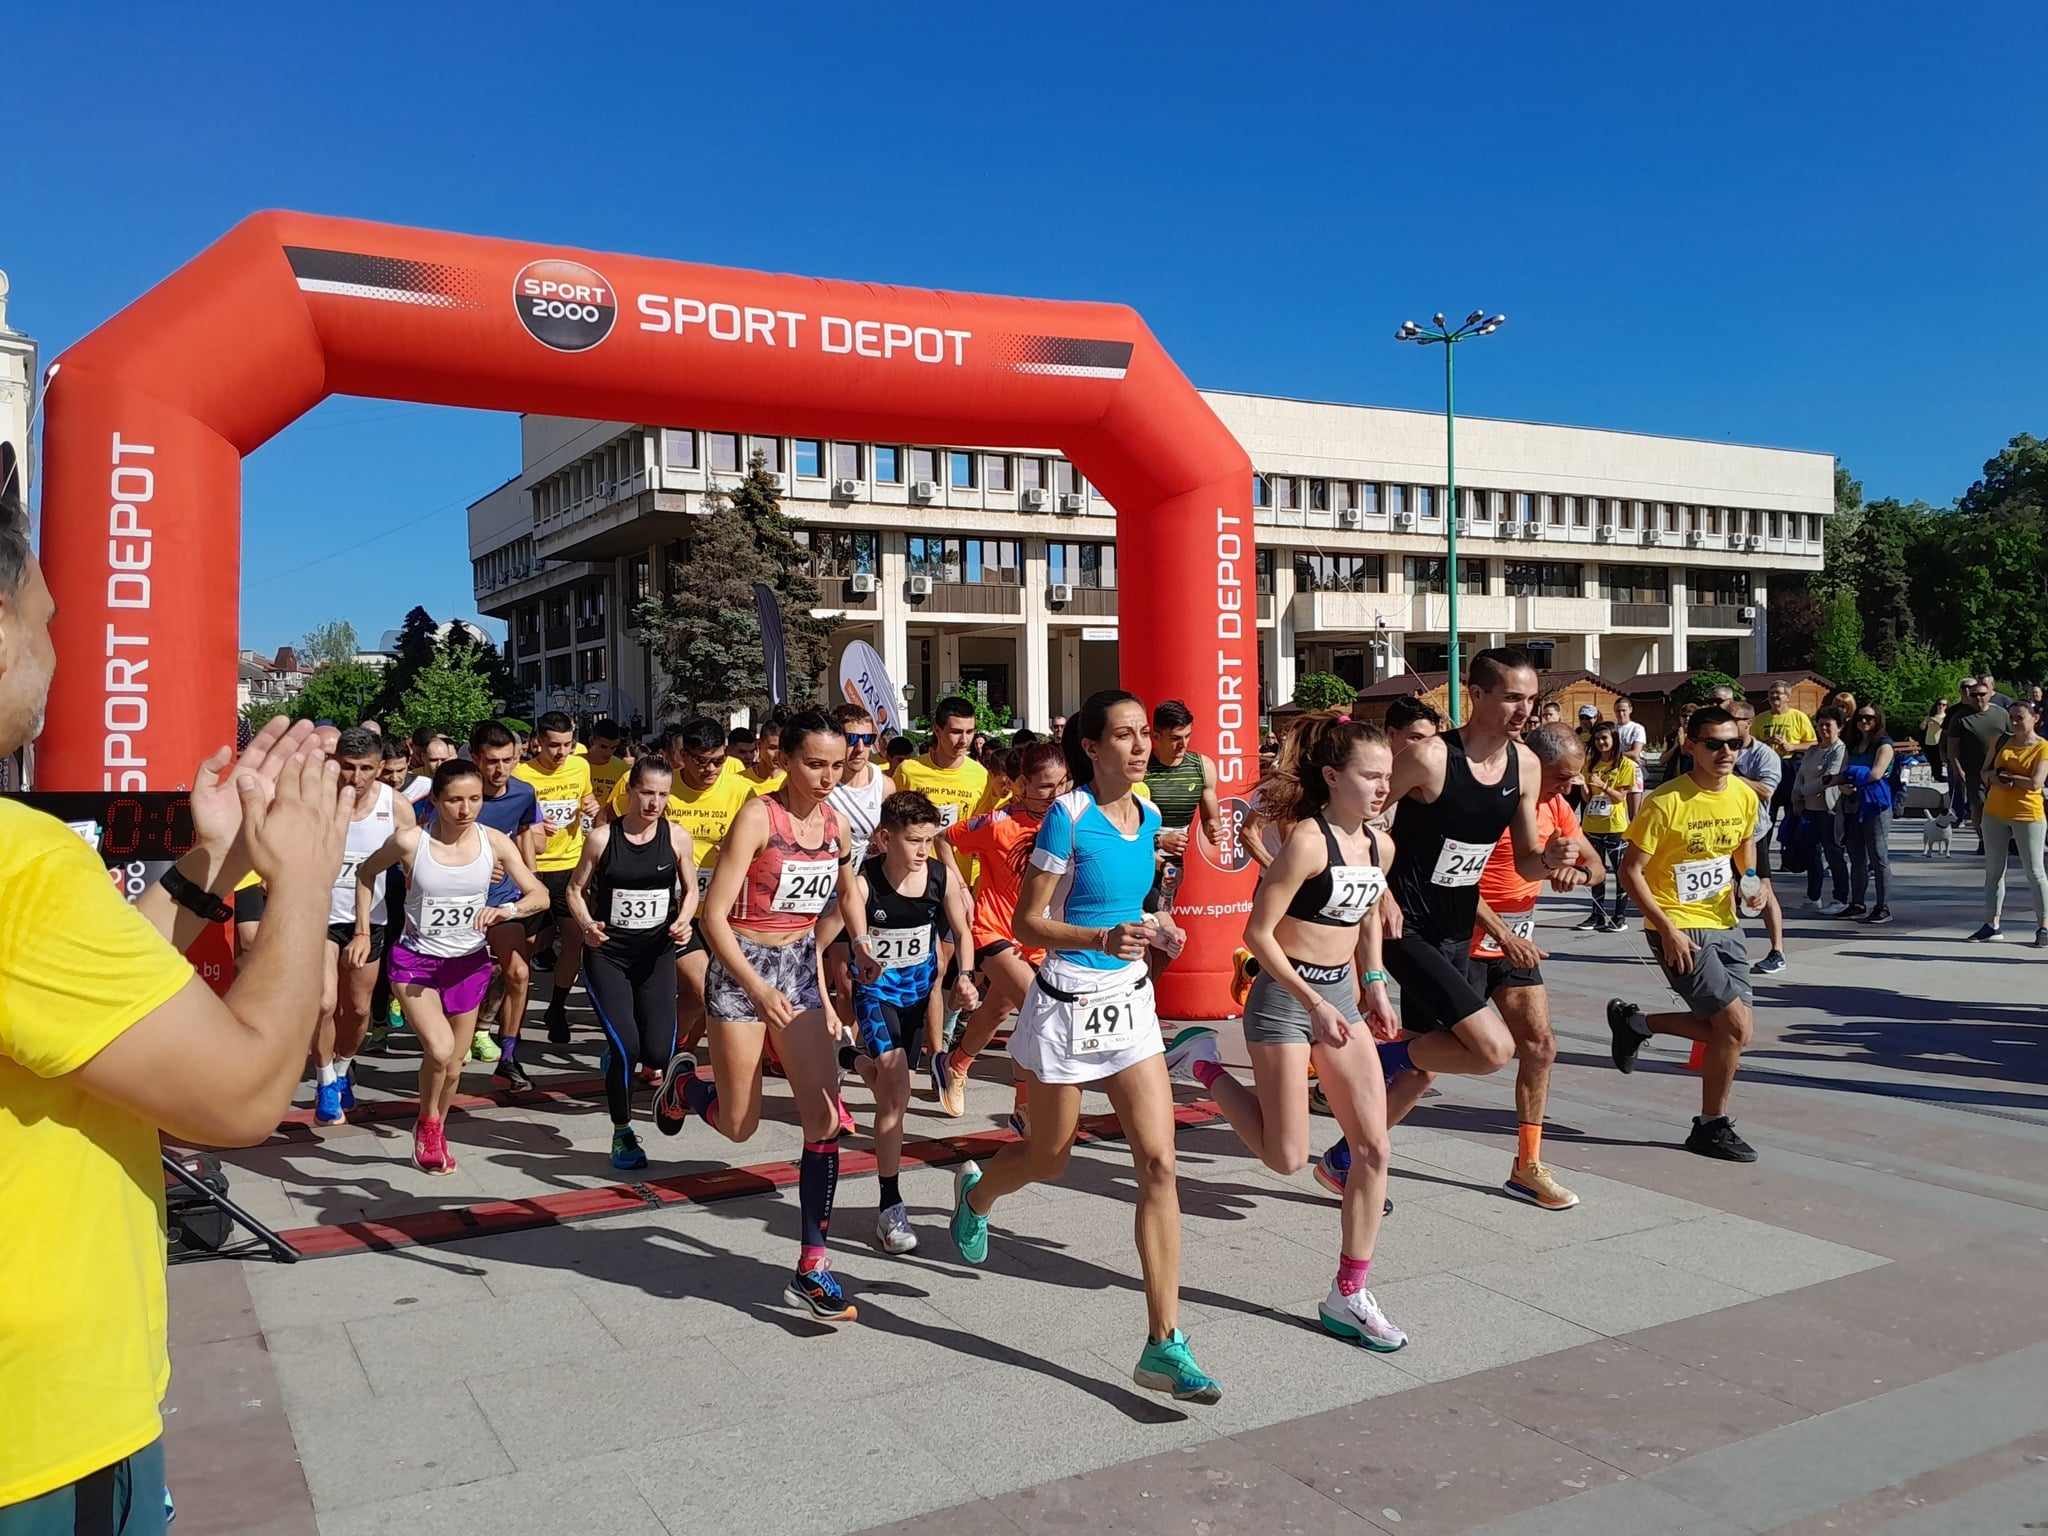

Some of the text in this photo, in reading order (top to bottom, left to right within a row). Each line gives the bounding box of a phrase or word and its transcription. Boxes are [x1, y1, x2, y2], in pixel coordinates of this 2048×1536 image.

[524, 278, 606, 304] SPORT
[532, 298, 600, 323] 2000
[637, 293, 972, 366] SPORT DEPOT
[107, 432, 155, 608] DEPOT
[1217, 507, 1243, 783] SPORT DEPOT
[693, 810, 710, 819] РЪН
[711, 811, 728, 819] 2024
[1219, 806, 1232, 865] SPORT
[1446, 854, 1487, 876] 244
[786, 875, 832, 899] 240
[1687, 868, 1724, 891] 305
[1338, 883, 1379, 908] 272
[430, 906, 474, 926] 239
[620, 901, 657, 918] 331
[876, 938, 920, 959] 218
[1296, 964, 1342, 981] NIKE
[1085, 1003, 1133, 1034] 491
